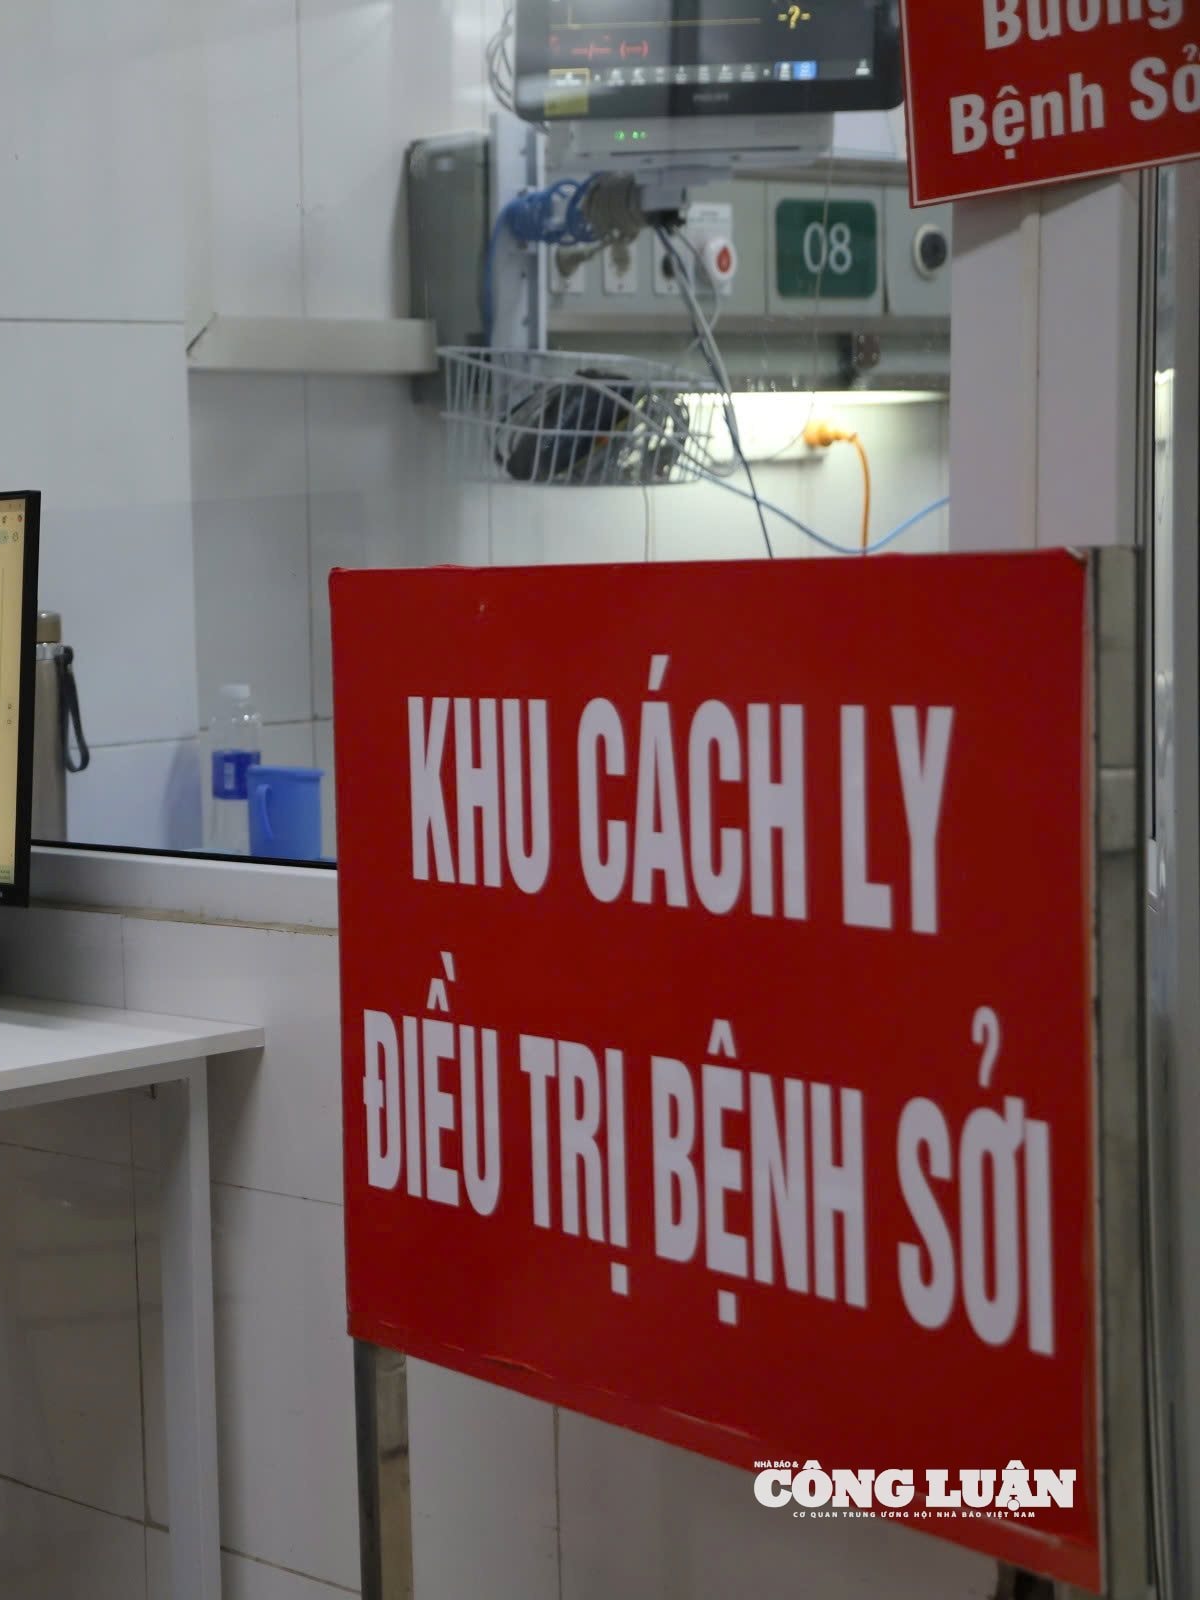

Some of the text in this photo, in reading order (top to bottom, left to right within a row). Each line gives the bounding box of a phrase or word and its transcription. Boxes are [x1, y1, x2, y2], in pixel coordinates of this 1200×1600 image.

[949, 71, 1105, 160] Bệnh
[803, 224, 852, 273] 08
[406, 654, 955, 935] KHU CÁCH LY
[362, 950, 1055, 1357] ĐIỀU TRỊ BỆNH SỞI
